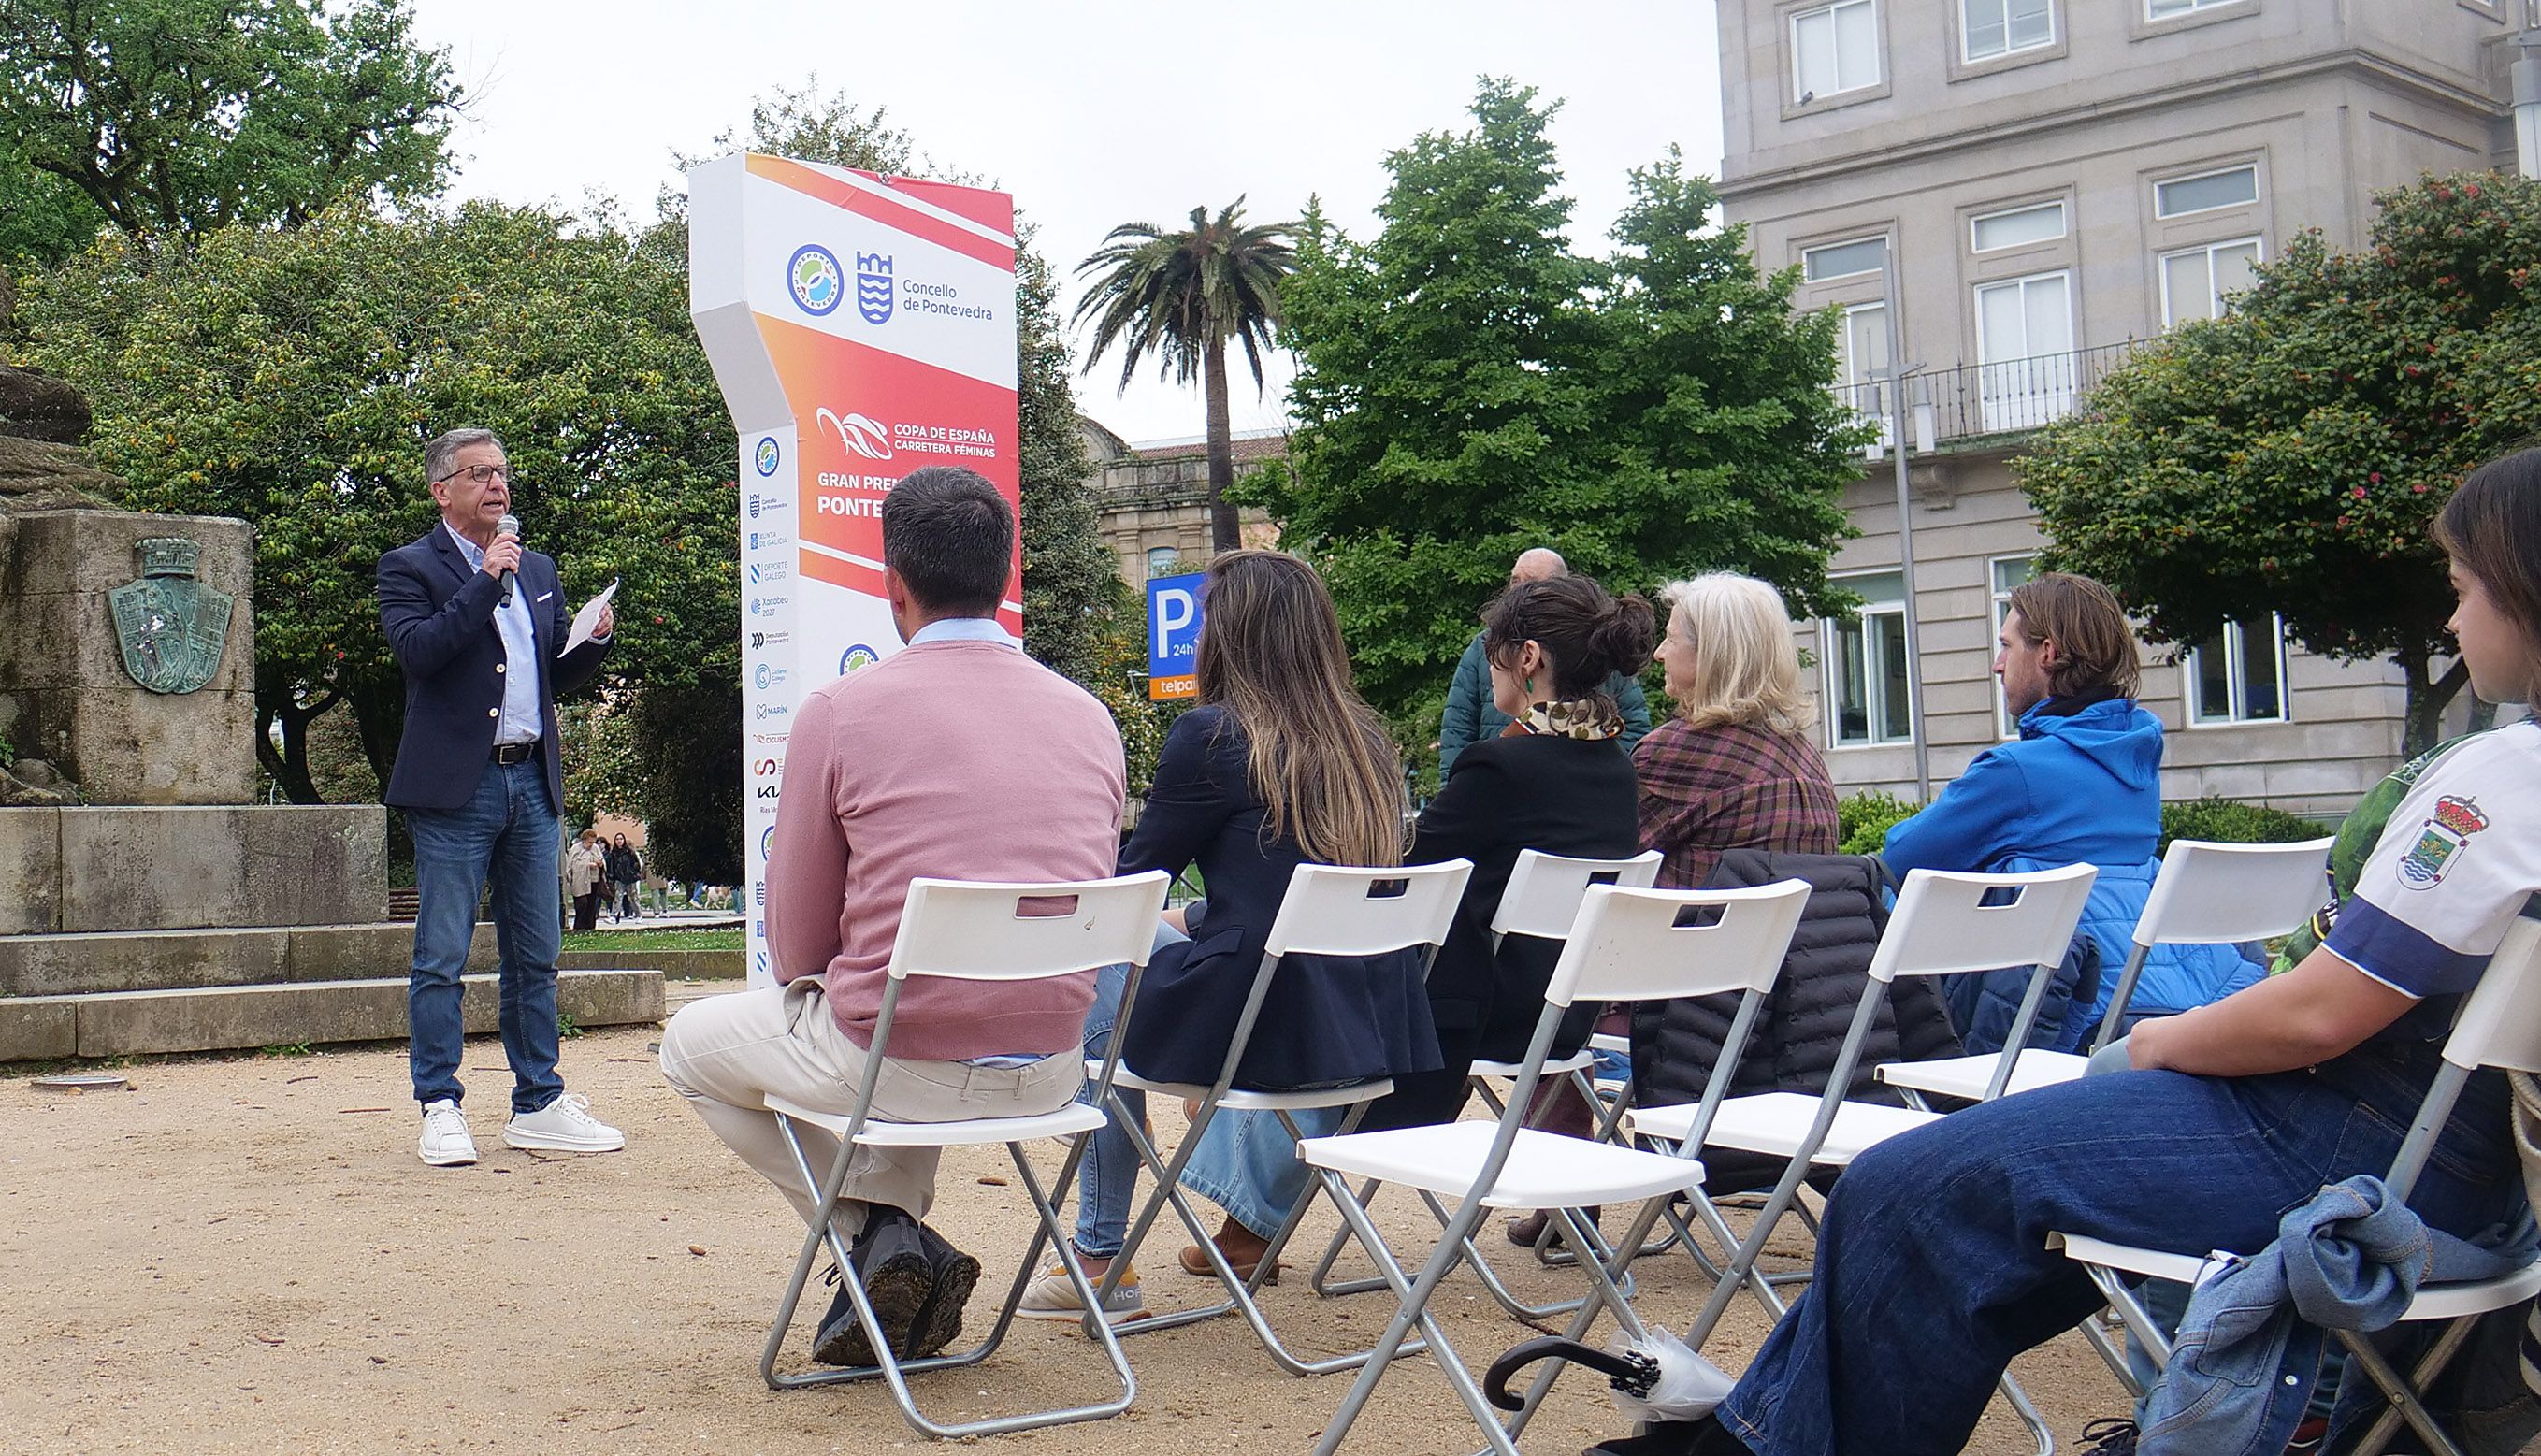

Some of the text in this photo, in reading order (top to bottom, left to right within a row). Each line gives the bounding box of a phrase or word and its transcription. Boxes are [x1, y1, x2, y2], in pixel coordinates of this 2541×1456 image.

[797, 252, 833, 270] DEPORTE
[794, 279, 837, 308] PONTEVEDRA
[902, 279, 957, 298] Concello
[903, 297, 993, 321] de Pontevedra
[894, 424, 995, 444] COPA DE ESPAÑA
[894, 440, 996, 458] CARRETERA FÉMINAS
[817, 472, 902, 492] GRAN PRE
[817, 496, 884, 518] PONTE
[762, 596, 788, 606] Xacobeo
[1155, 588, 1195, 659] P
[1173, 642, 1194, 656] 24h
